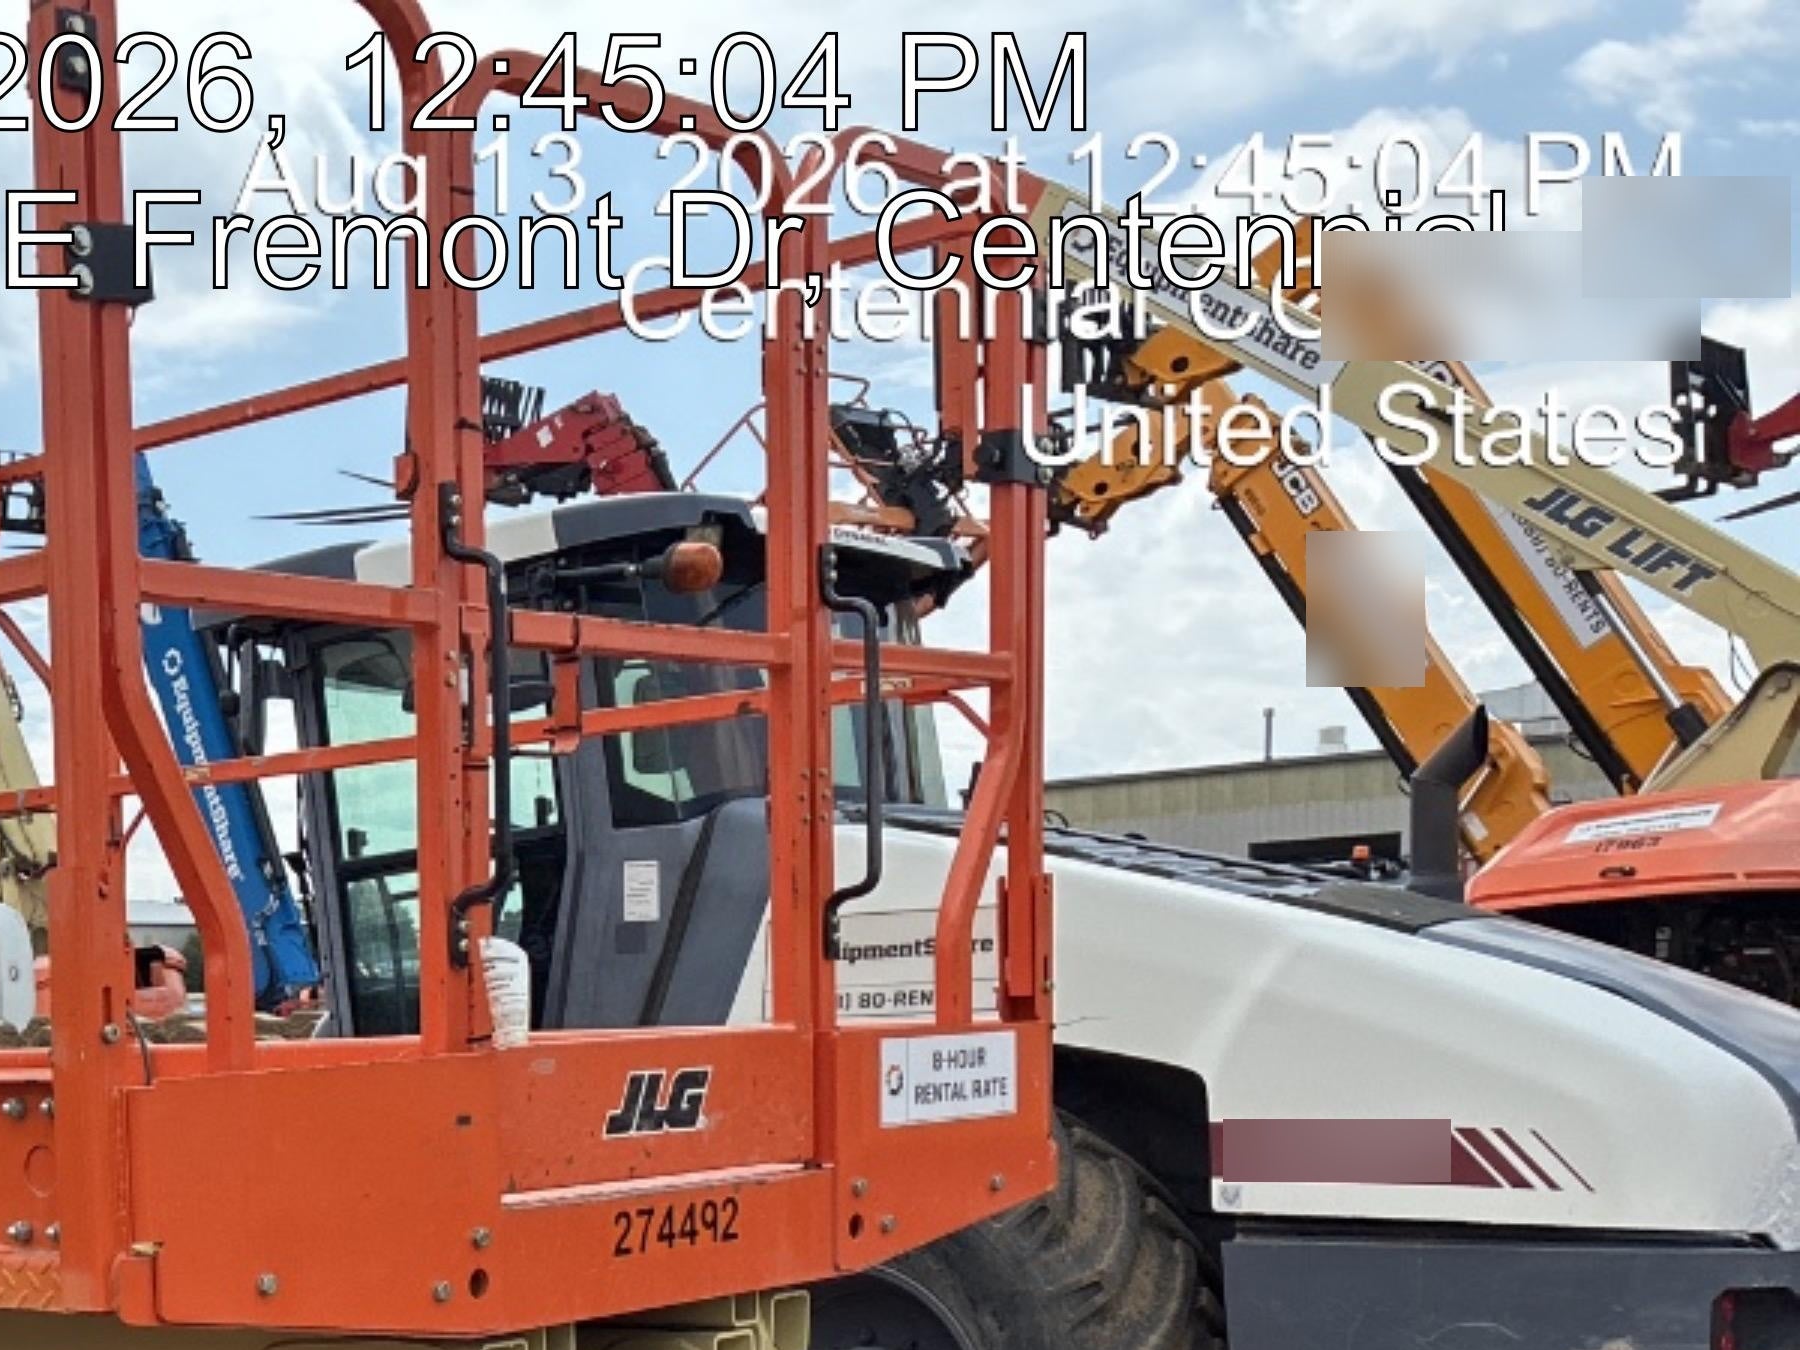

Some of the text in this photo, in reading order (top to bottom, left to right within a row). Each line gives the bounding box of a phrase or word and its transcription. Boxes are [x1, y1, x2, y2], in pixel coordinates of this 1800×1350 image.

[1523, 487, 1717, 592] JLG LIFT
[603, 1064, 715, 1140] JLG
[914, 1075, 1009, 1105] RENTAL RATE
[613, 1196, 740, 1258] 274492
